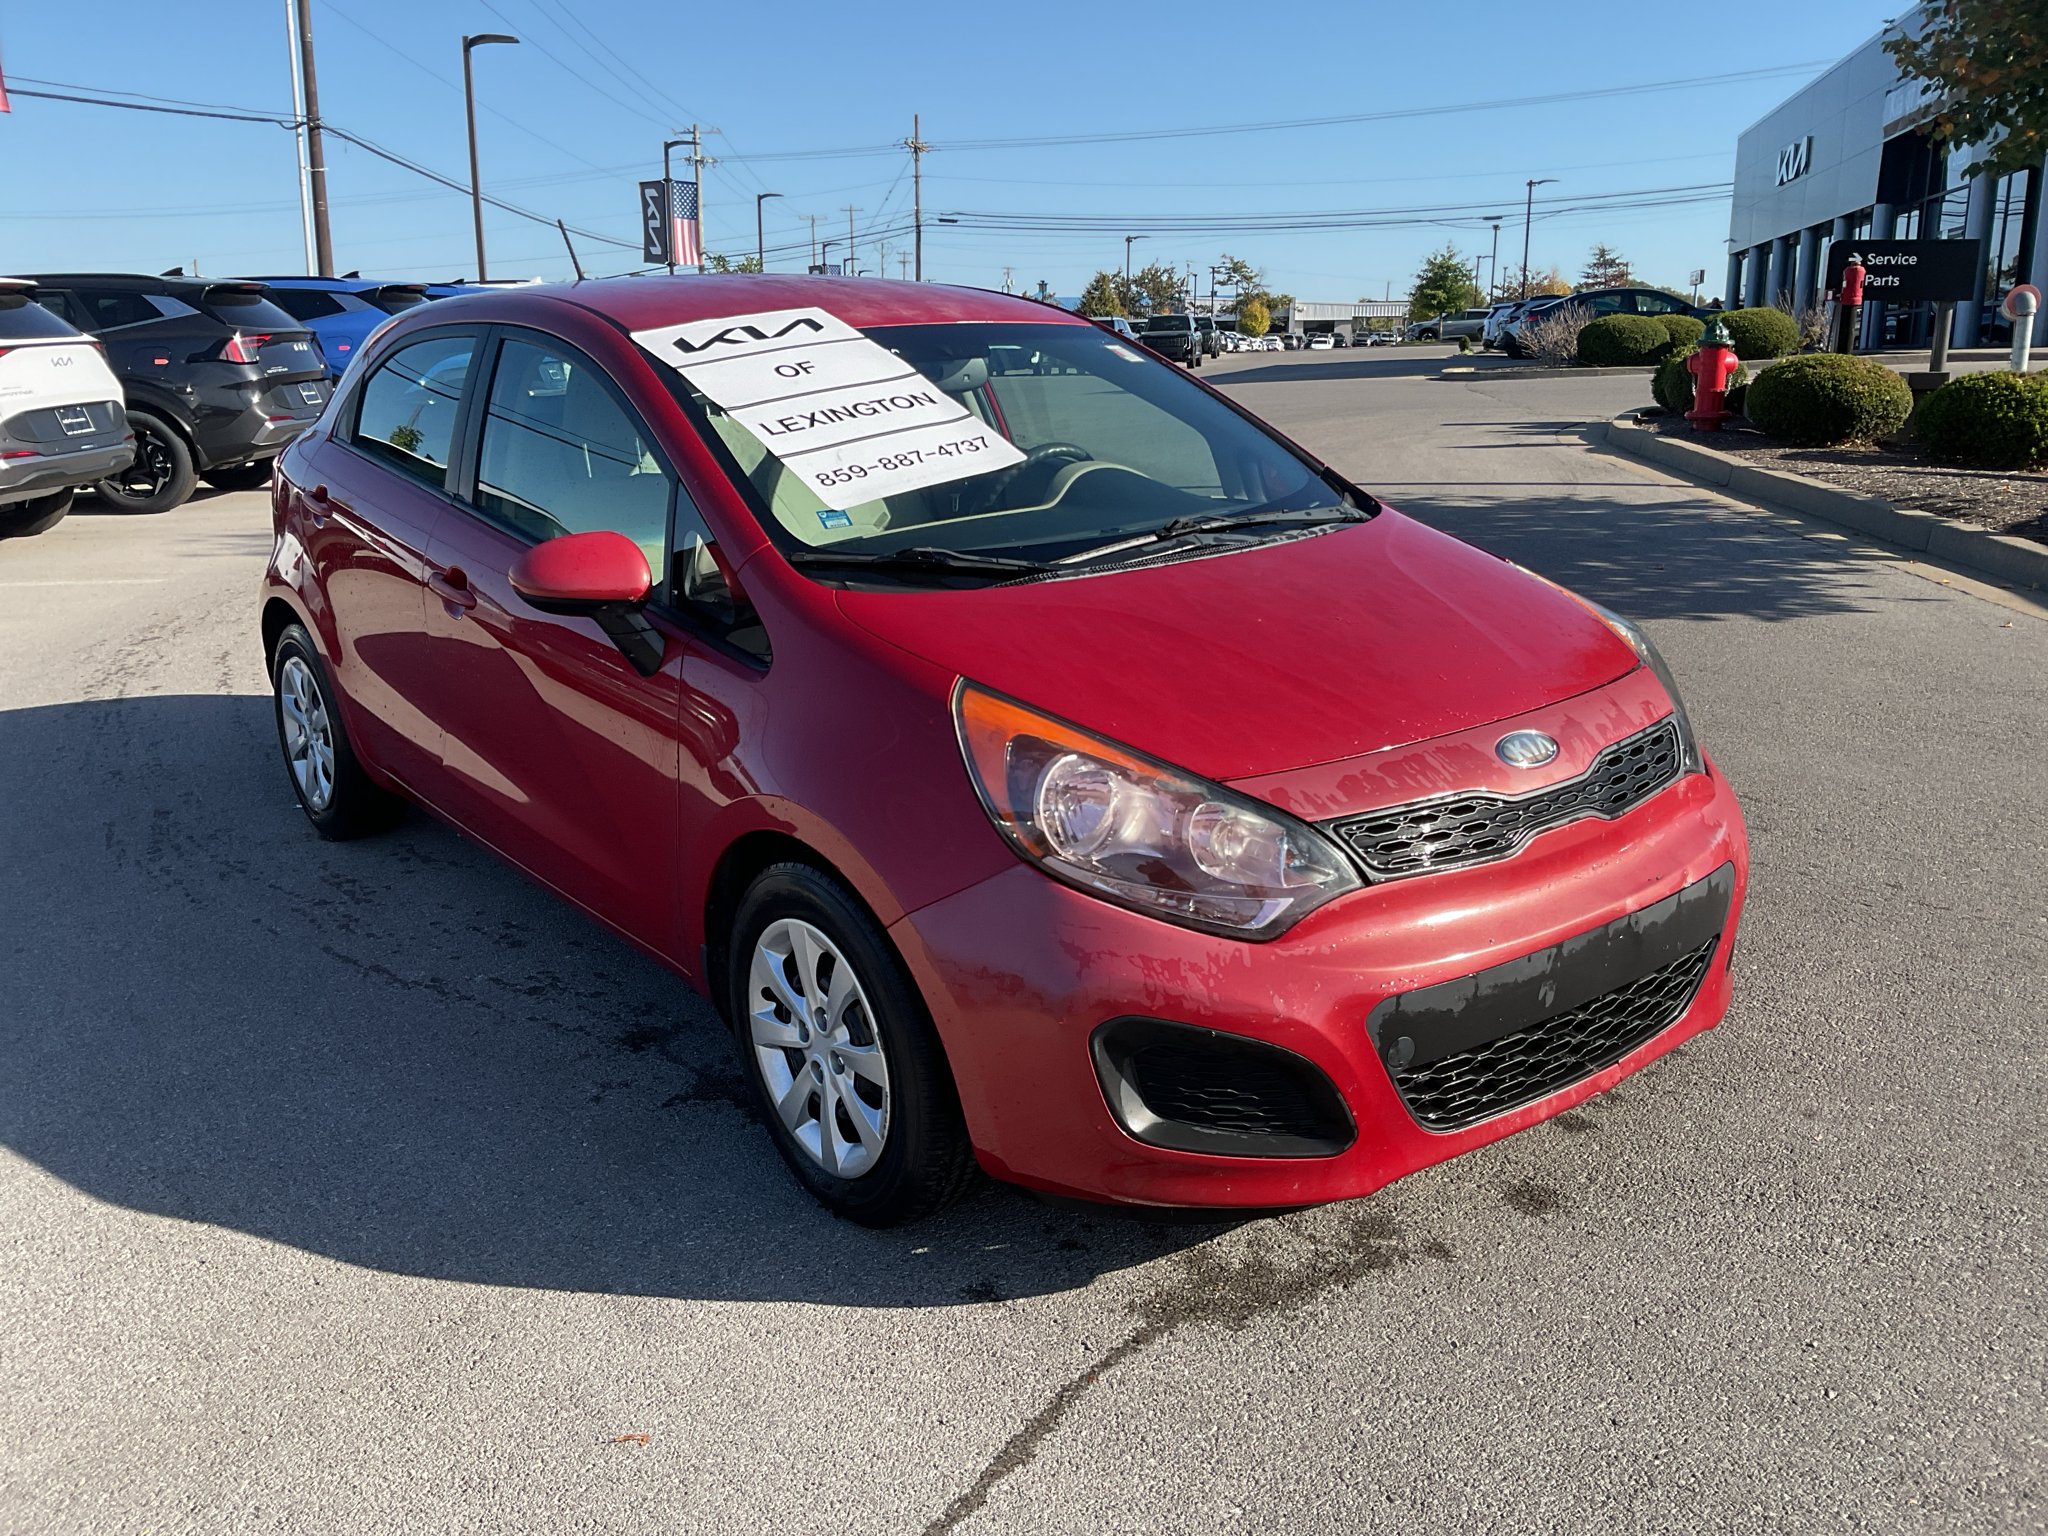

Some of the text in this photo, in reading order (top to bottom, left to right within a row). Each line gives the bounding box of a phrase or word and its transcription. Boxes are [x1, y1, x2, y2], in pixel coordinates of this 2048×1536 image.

[1867, 253, 1918, 265] Service
[1864, 274, 1900, 286] Parts
[773, 360, 816, 379] OF
[758, 391, 939, 437] LEXINGTON
[815, 436, 991, 488] 859-887-4737
[1504, 735, 1555, 762] KIA
